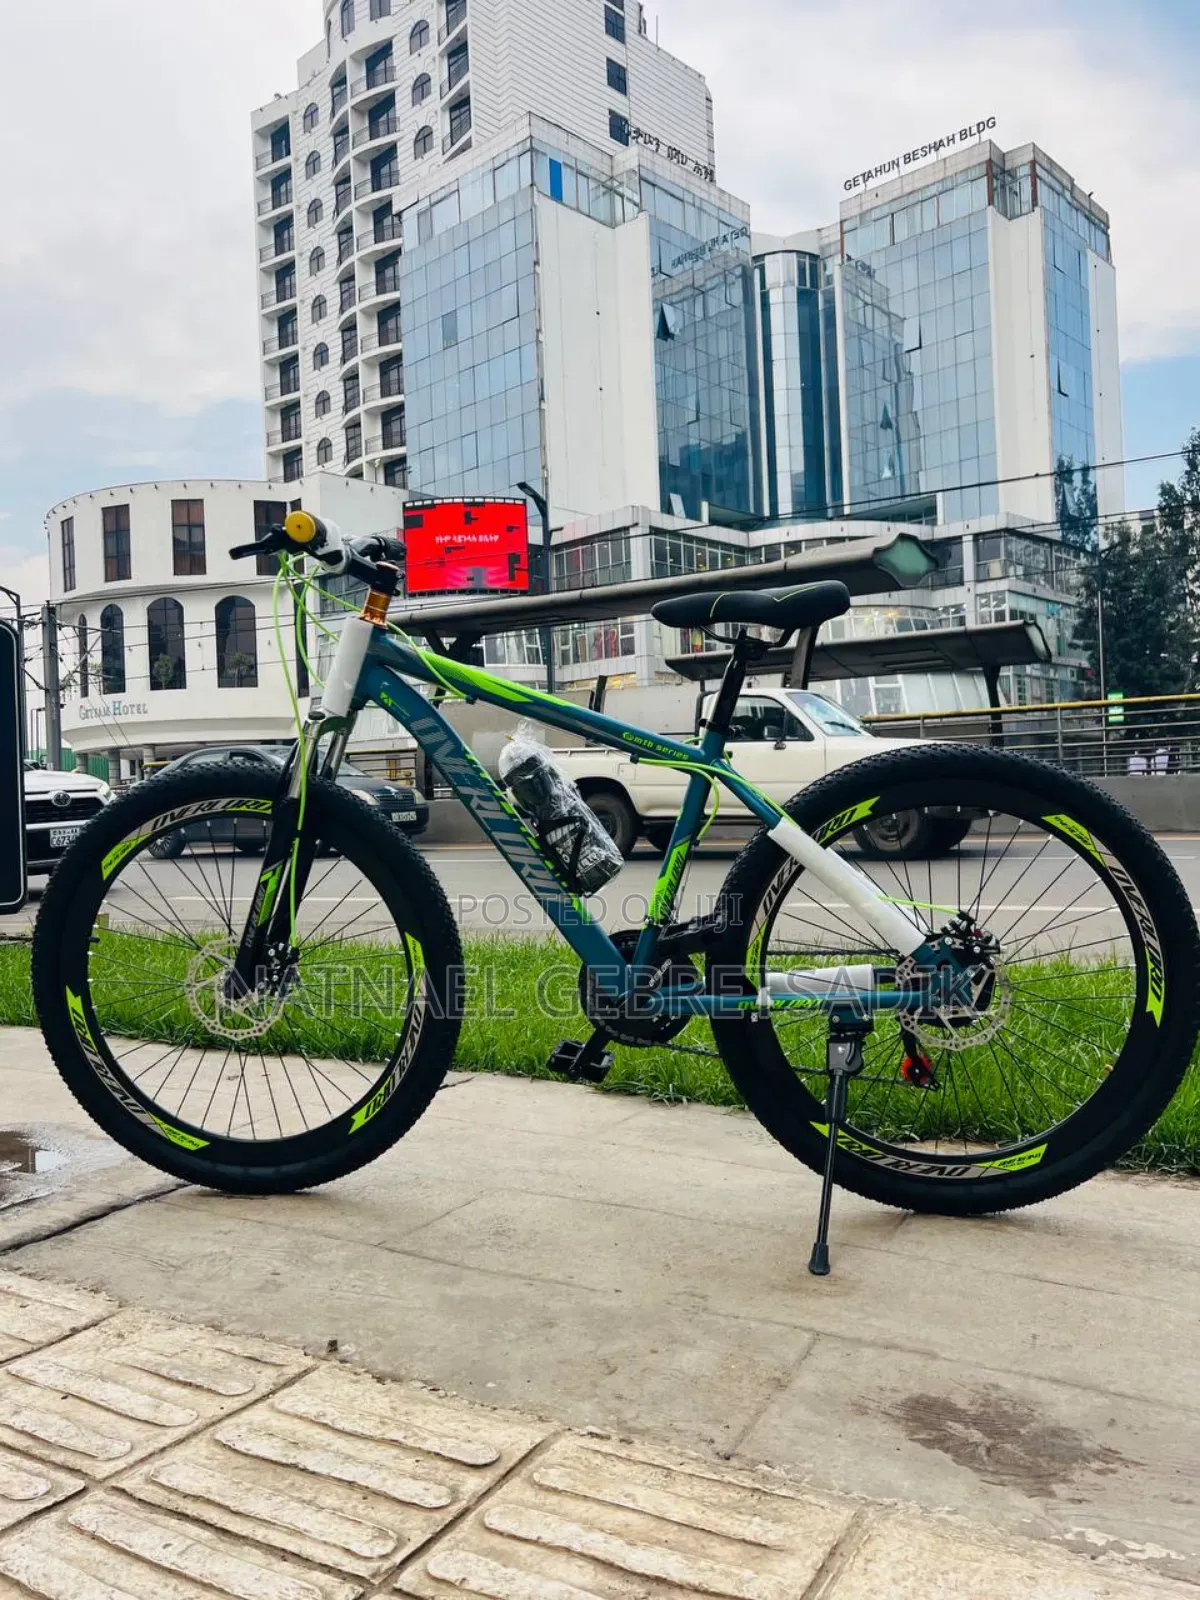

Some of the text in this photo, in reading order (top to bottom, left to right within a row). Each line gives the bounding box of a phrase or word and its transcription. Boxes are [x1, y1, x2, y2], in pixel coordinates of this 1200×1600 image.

[843, 116, 997, 191] GETAHUN BESHAH BLDG
[113, 700, 148, 716] HOTEL
[410, 717, 567, 903] OVERLORD
[1108, 865, 1164, 1001] OVERLORD
